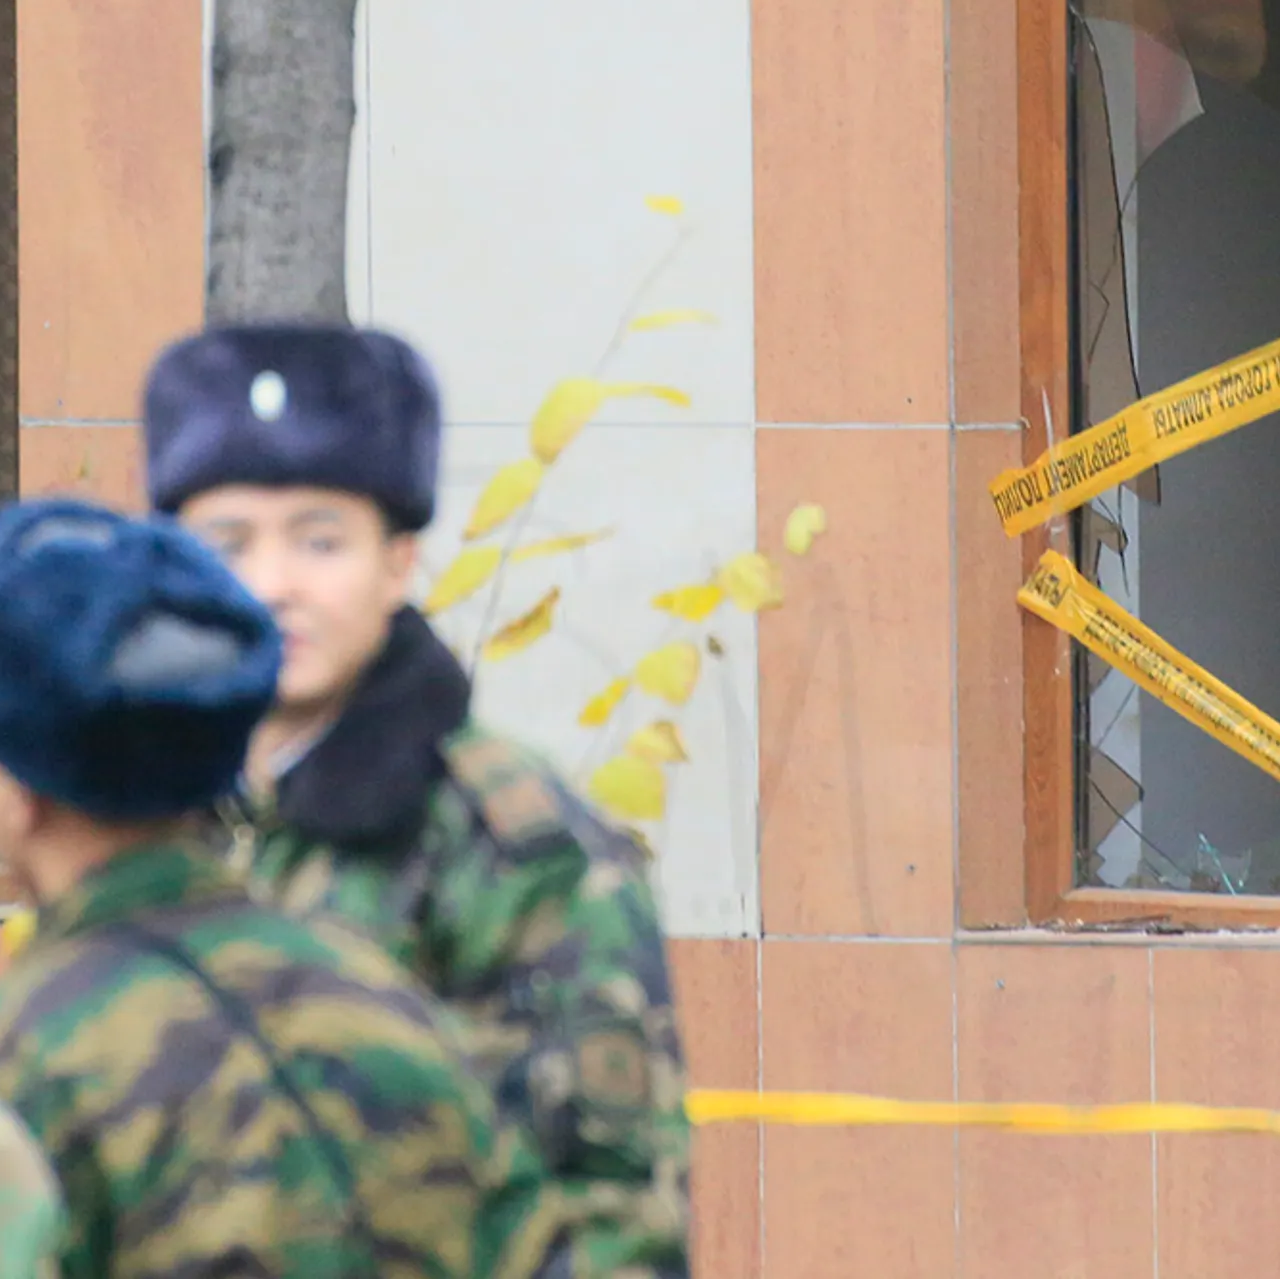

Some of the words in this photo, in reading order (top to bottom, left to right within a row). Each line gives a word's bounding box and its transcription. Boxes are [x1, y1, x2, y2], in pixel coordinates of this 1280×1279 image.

[1152, 385, 1213, 440] АЛМАТЫ
[1213, 358, 1272, 412] ГОРОДА
[1041, 419, 1132, 497] ДЕПАРТАМЕНТ
